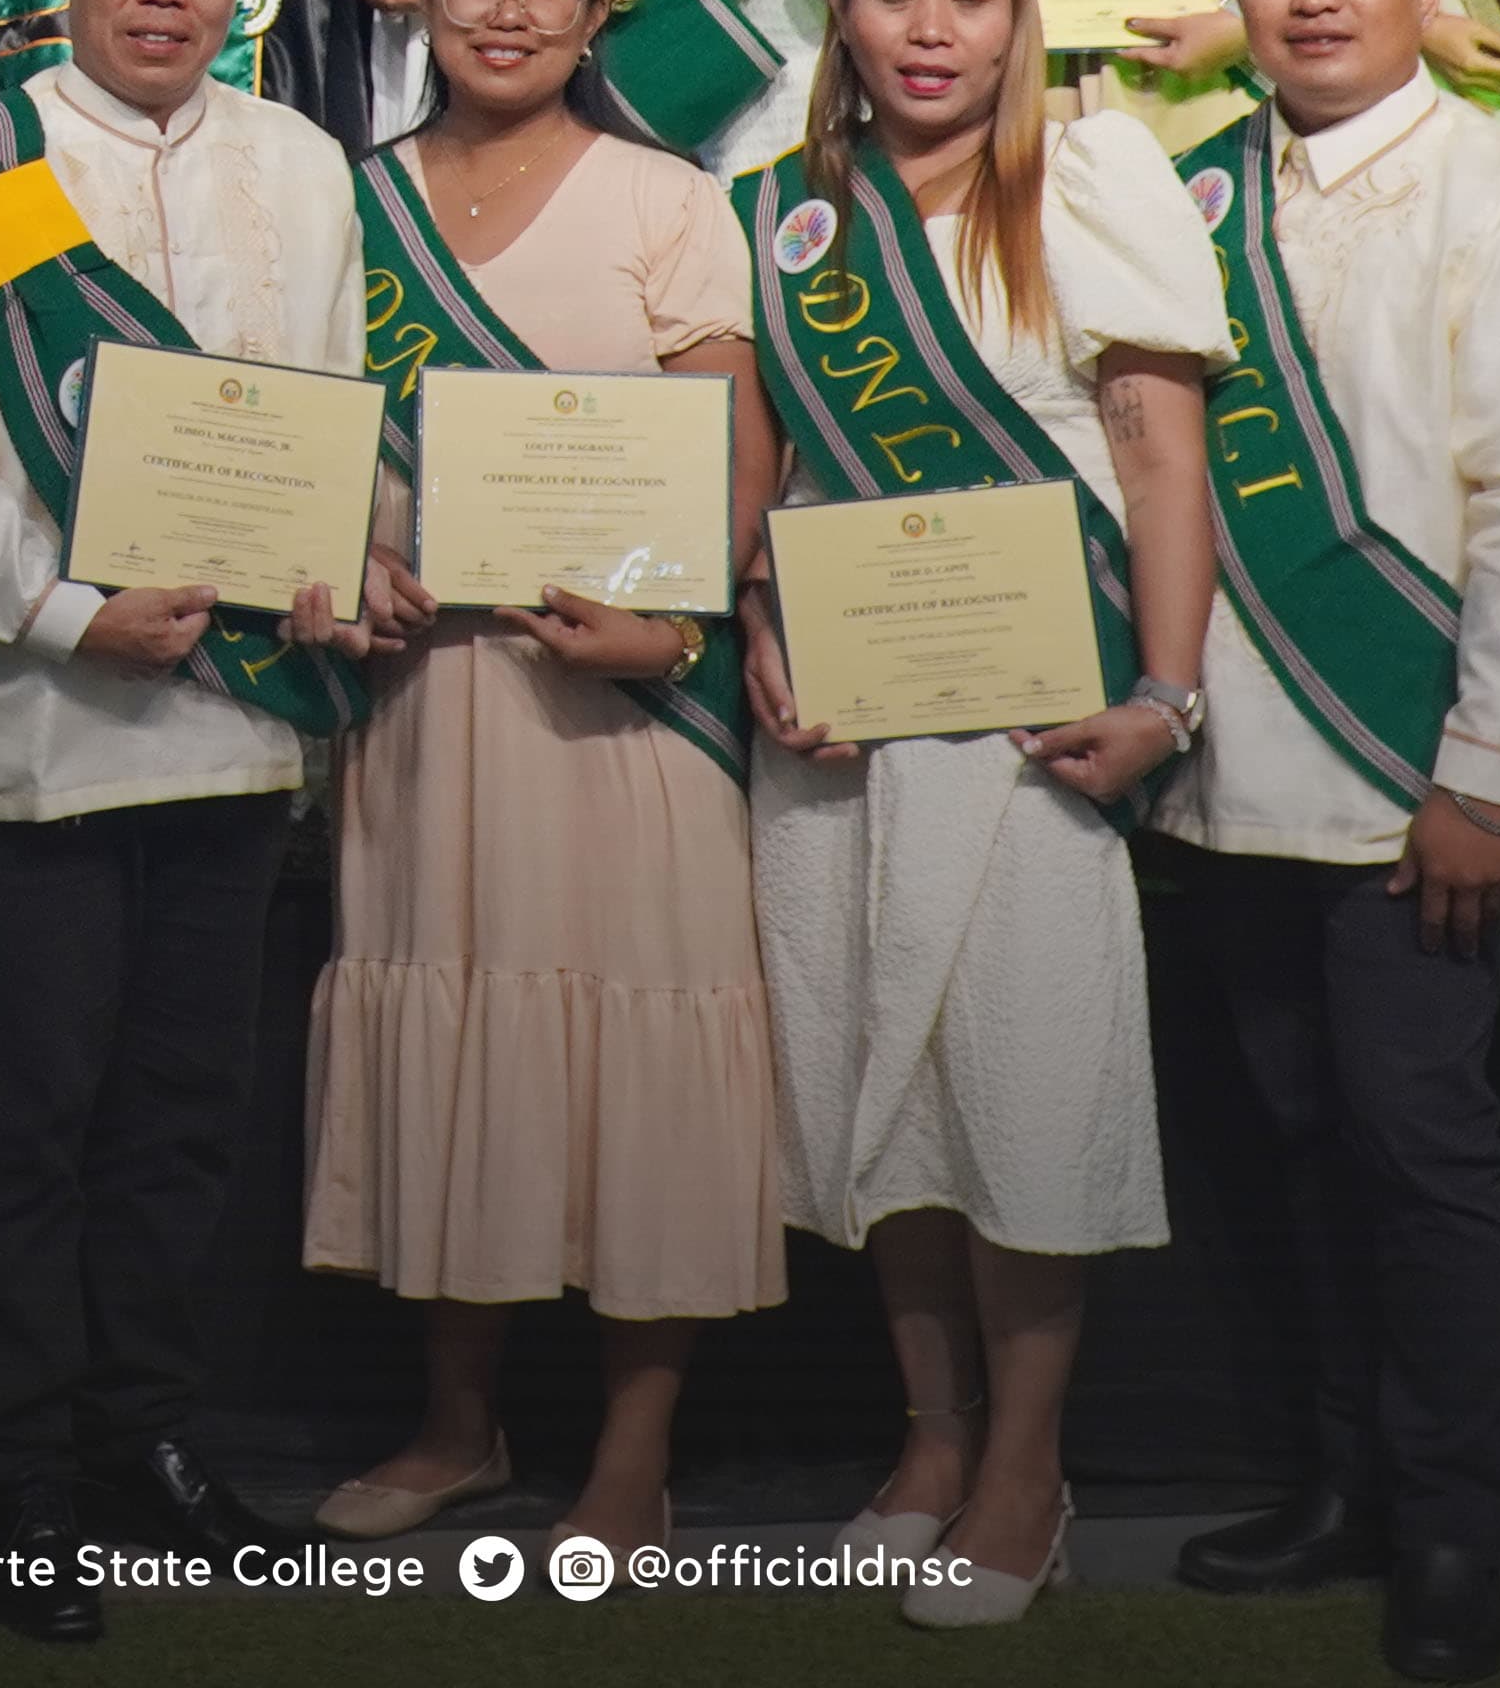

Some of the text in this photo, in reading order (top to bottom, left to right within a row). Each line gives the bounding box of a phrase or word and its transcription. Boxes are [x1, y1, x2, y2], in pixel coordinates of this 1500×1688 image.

[798, 269, 968, 487] DNL
[142, 454, 316, 491] CERTIFICATE OF RECOGNITION
[481, 472, 667, 488] CERTIFICATE OF RECOGNITION
[842, 599, 918, 618] CERTIFICATE
[939, 591, 1029, 610] RECOGNITION
